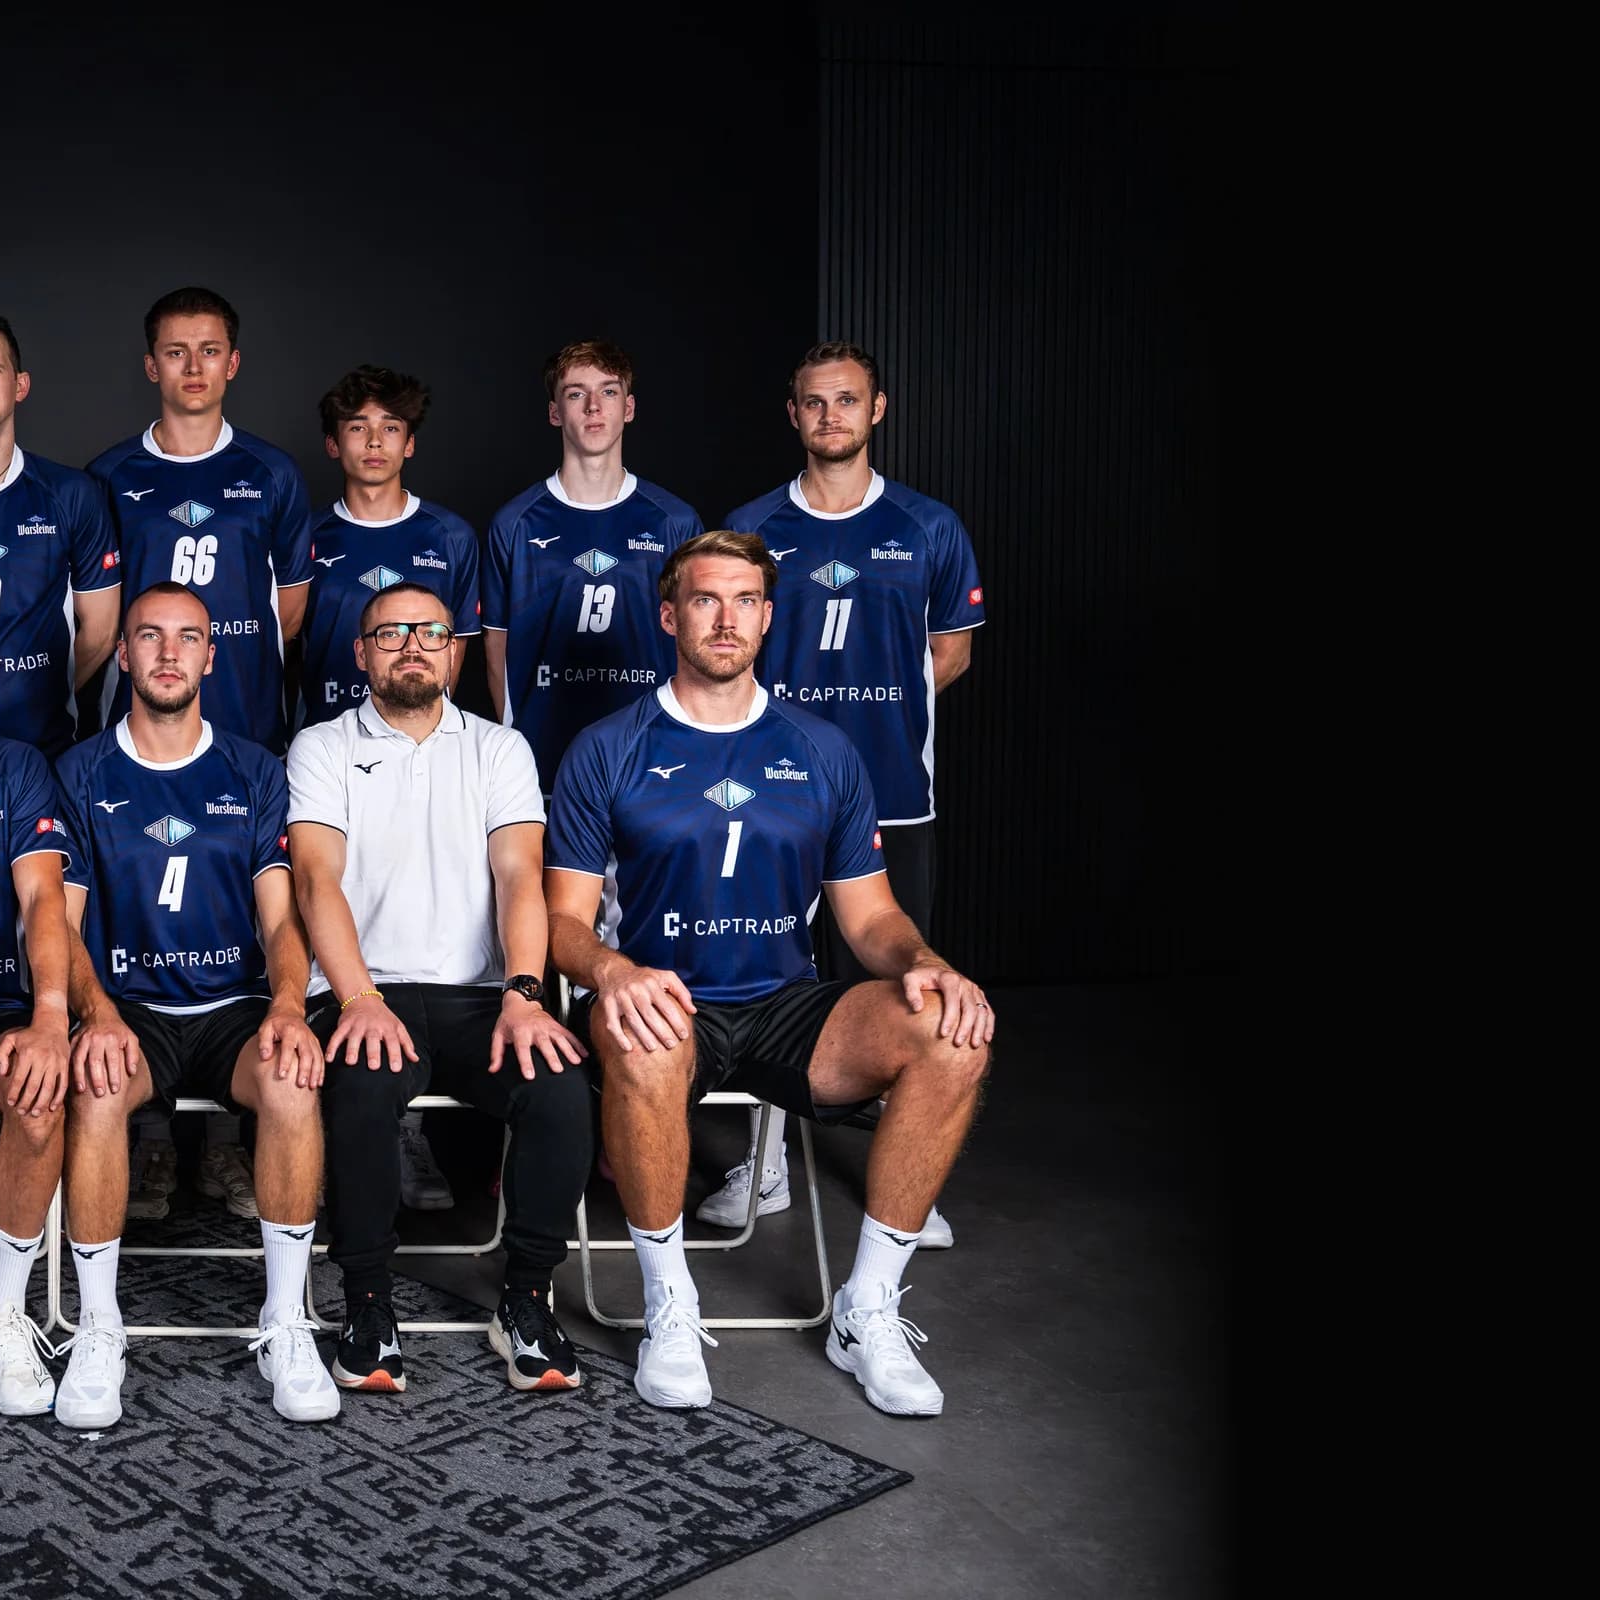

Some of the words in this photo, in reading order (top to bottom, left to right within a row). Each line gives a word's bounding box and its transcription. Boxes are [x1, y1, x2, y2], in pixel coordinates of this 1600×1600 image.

[224, 487, 261, 498] Warsteiner
[628, 539, 664, 552] Warsteiner
[872, 547, 912, 560] Warsteiner
[171, 535, 218, 585] 66
[578, 584, 615, 632] 13
[211, 620, 259, 635] RADER
[820, 599, 852, 650] 11
[565, 668, 656, 684] CAPTRADER
[764, 766, 808, 780] Warsteiner
[206, 802, 248, 816] Warsteiner
[721, 821, 743, 877] 1
[158, 856, 188, 912] 4
[695, 916, 796, 935] CAPTRADER
[143, 947, 240, 967] CAPTRADER
